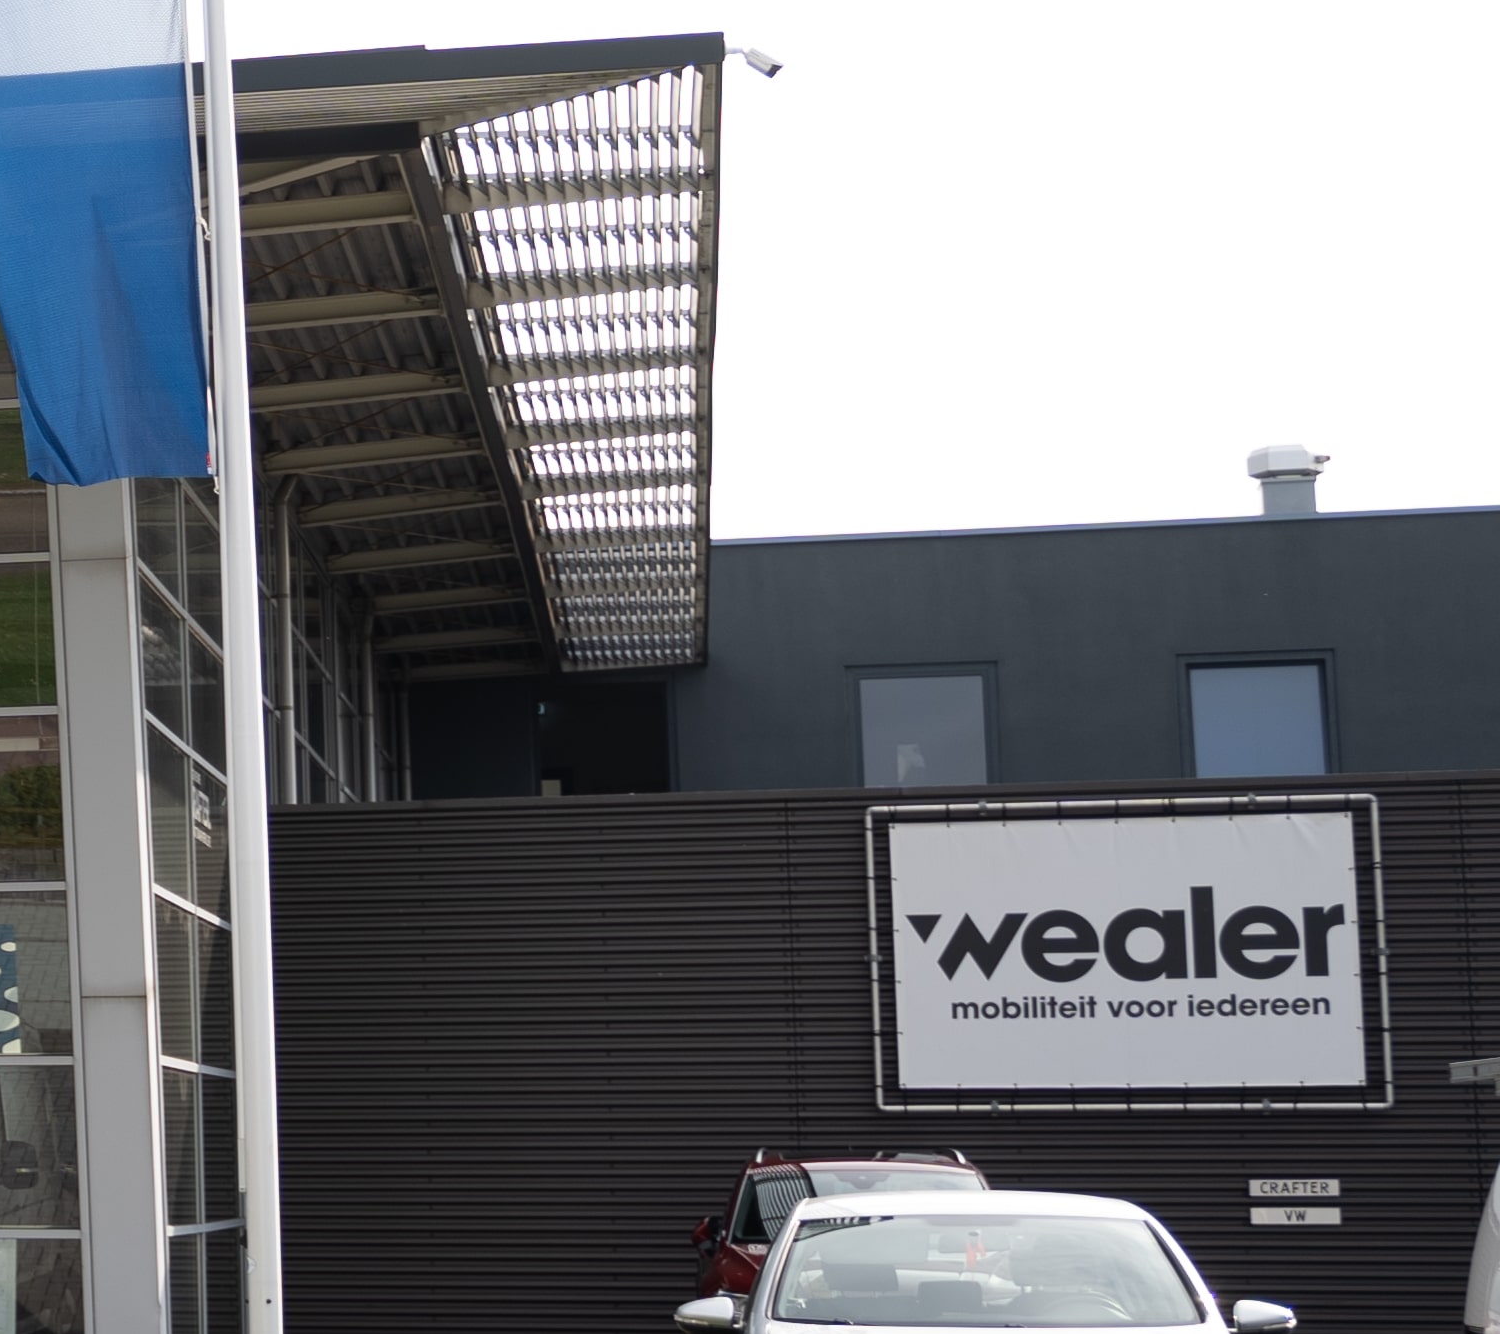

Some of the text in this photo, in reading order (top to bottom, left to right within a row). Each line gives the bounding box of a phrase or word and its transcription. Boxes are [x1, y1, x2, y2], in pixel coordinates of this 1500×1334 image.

[951, 993, 1331, 1020] mobiliteit voor iedereen
[1260, 1181, 1330, 1195] CRAFTER
[1283, 1209, 1308, 1222] VW
